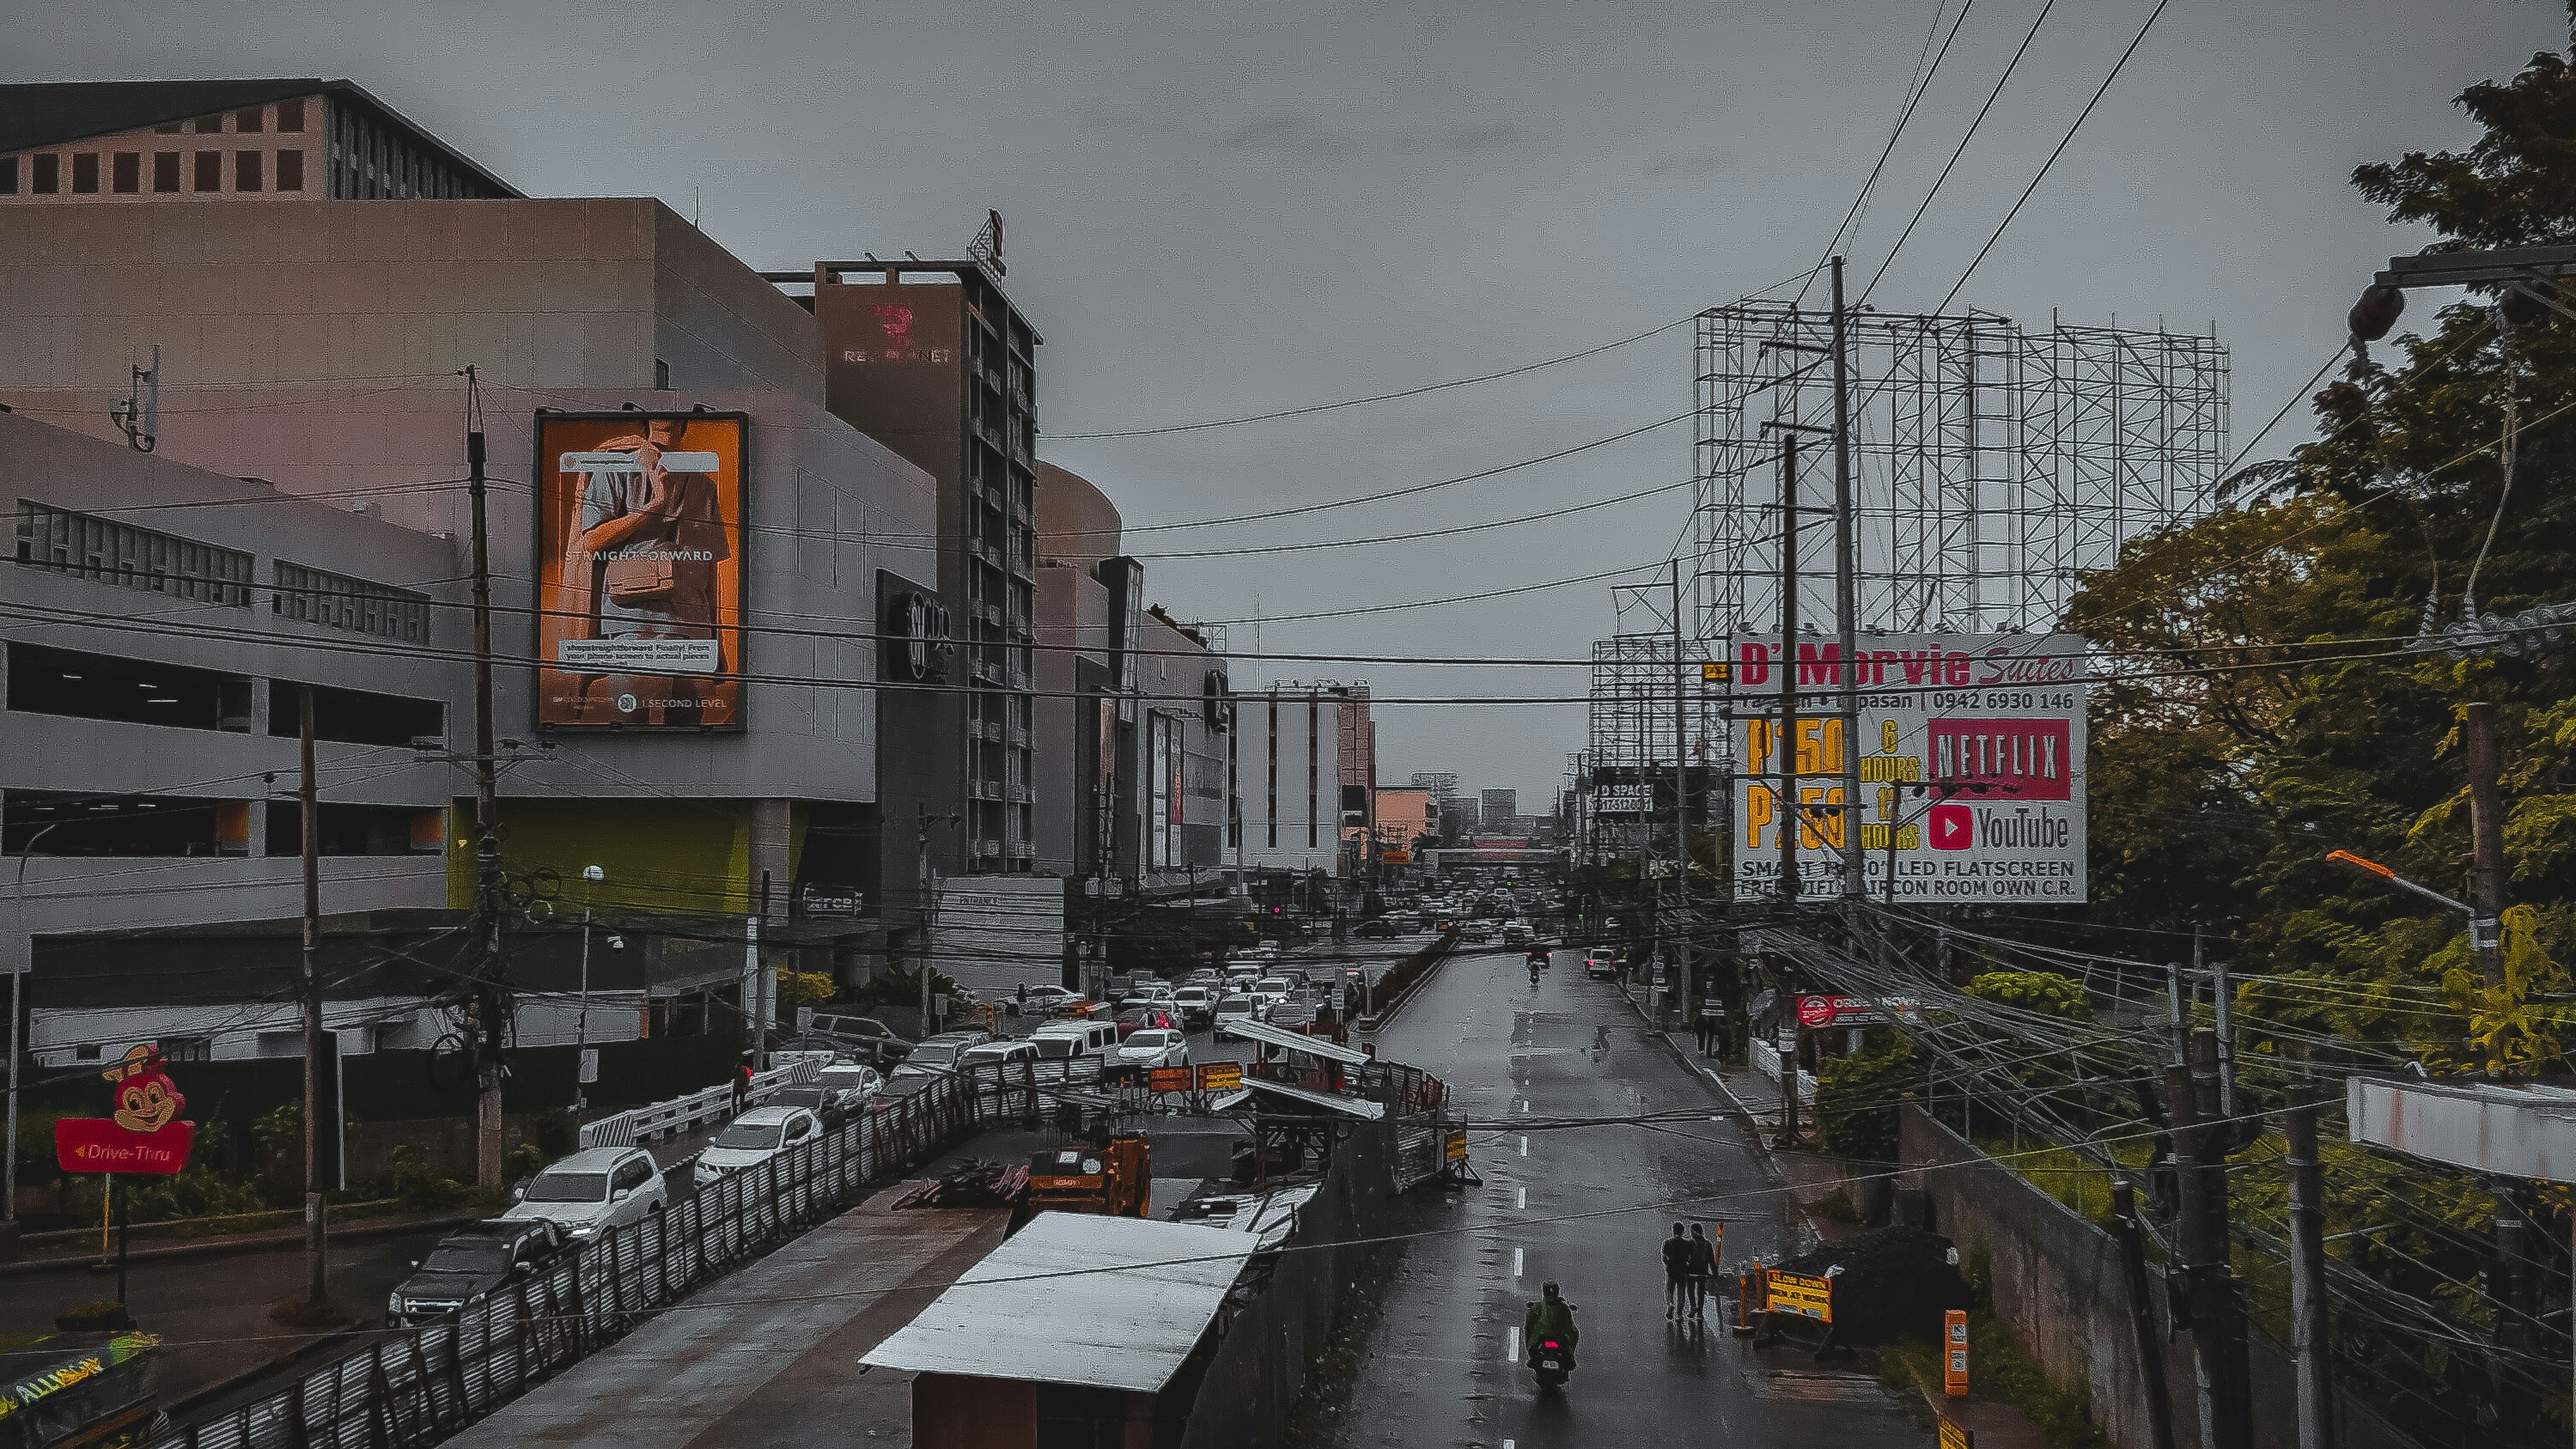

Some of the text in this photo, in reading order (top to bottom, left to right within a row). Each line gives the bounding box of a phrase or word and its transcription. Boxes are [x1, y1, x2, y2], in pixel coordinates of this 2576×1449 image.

[565, 551, 713, 562] STRAIGHTFORWARD
[1978, 647, 2074, 685] Suites
[648, 698, 728, 708] SECOND LEVEL
[1934, 693, 1981, 709] 0942
[1986, 693, 2033, 709] 6930
[2039, 693, 2074, 709] 146
[1881, 720, 1897, 753] 6
[1938, 734, 2056, 779] NETFLIX
[1860, 756, 1920, 782] HOURS
[1612, 784, 1650, 795] SPACE
[1977, 807, 2068, 849] YouTube
[1898, 861, 1936, 876] LED
[1944, 861, 2074, 876] FLATSCREEN
[1934, 880, 1988, 895] ROOM
[1991, 880, 2037, 895] OWN
[2041, 880, 2075, 895] C.R.
[88, 1143, 171, 1162] Drive-Thru
[1771, 1272, 1827, 1290] SLOW DOWN
[1789, 1290, 1802, 1300] AT
[1803, 1293, 1830, 1305] WORK
